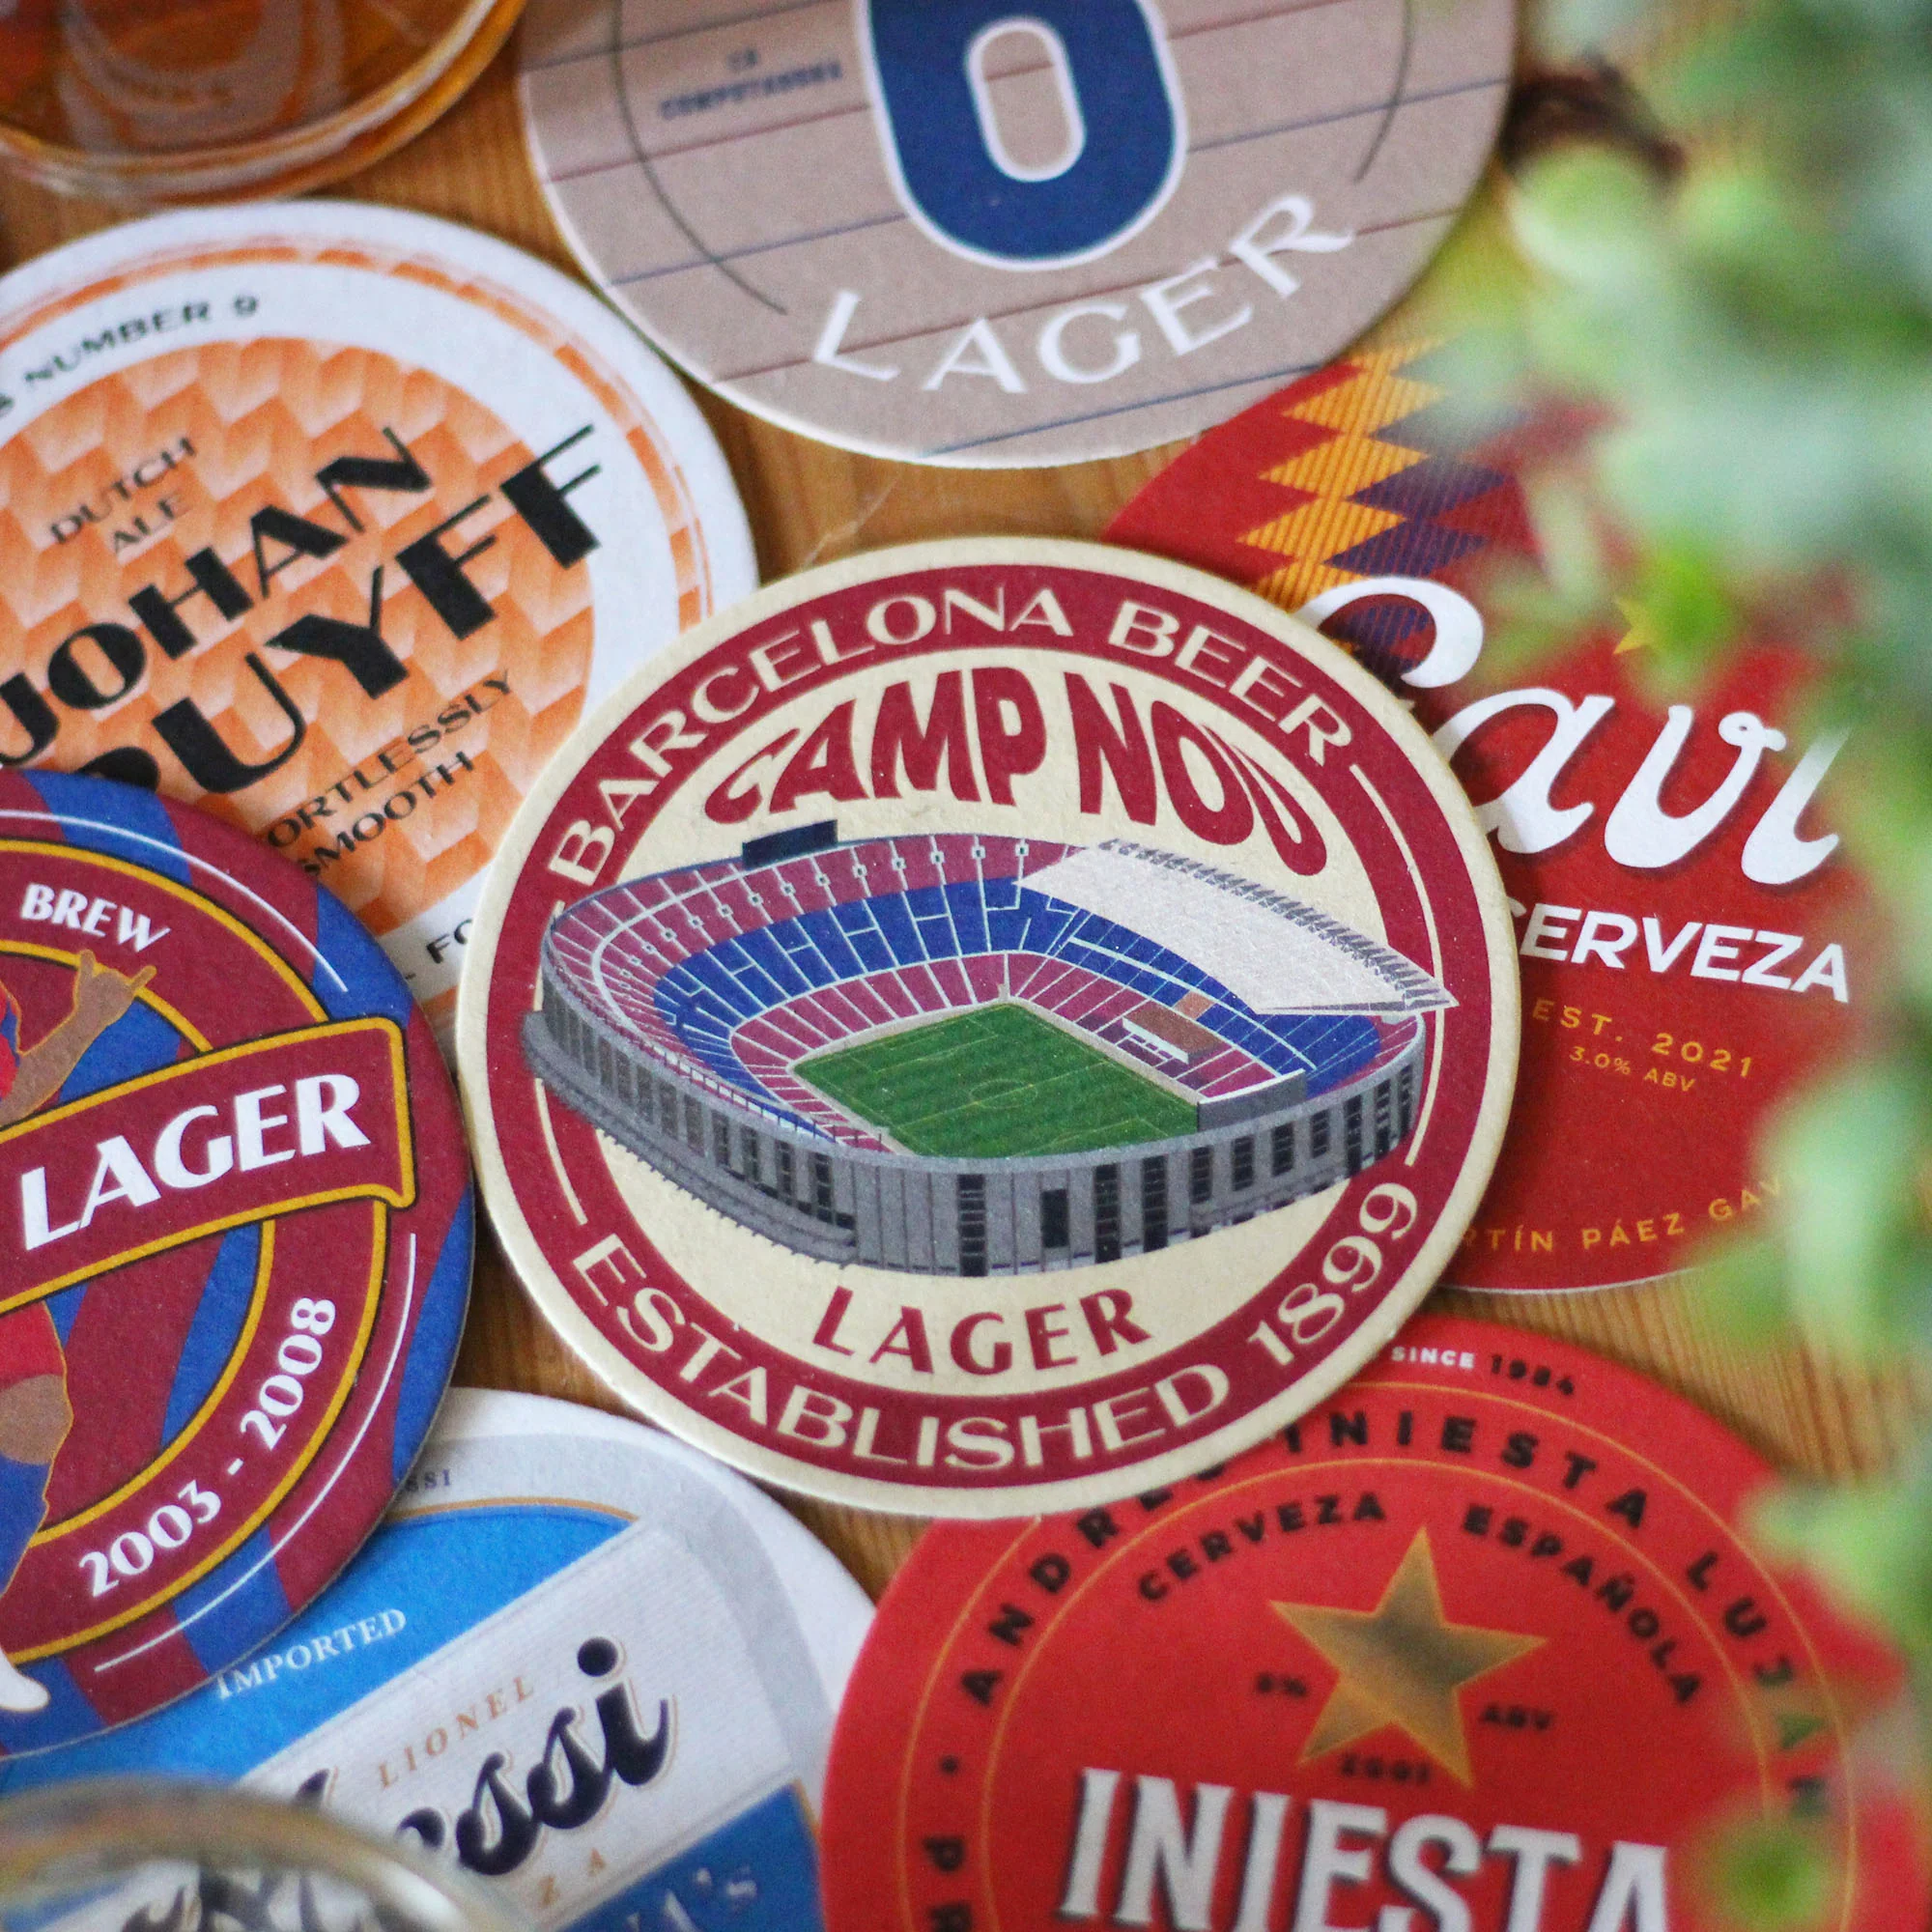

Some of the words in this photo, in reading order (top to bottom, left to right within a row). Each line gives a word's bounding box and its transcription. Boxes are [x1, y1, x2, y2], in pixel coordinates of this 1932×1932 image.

[24, 299, 211, 382] NUMBER
[233, 291, 259, 320] 9
[811, 193, 1355, 394] LAGER
[50, 436, 197, 544] DUTCH
[112, 490, 193, 554] ALE
[0, 426, 433, 766] JOHAN
[76, 424, 603, 794] UYFF
[267, 668, 511, 847] ORTLESSLY
[549, 582, 1074, 887] BARCELONA
[1108, 599, 1354, 769] BEER
[703, 666, 1048, 827] CAMP
[1063, 671, 1327, 876] NOU
[21, 883, 171, 953] BREW
[1508, 895, 1849, 1004] ERVEZA
[1532, 996, 1623, 1042] EST.
[1652, 1032, 1752, 1078] 2021
[1569, 1045, 1631, 1075] 3.0%
[1643, 1067, 1696, 1092] ABV
[19, 1073, 371, 1251] LAGER
[1581, 1211, 1685, 1249] PÁEZ
[574, 1235, 1230, 1472] ESTABLISHED
[1247, 1181, 1419, 1369] 1899
[812, 1285, 1152, 1377] LAGER
[1391, 1347, 1475, 1369] SINCE
[78, 1479, 222, 1598] 2003
[240, 1296, 336, 1451] 2008
[215, 1606, 408, 1701] IMPORTED
[1138, 1492, 1384, 1603] CERVEZA
[1464, 1503, 1701, 1707] ESPAÑOLA
[378, 1675, 535, 1789] LIONEL
[1060, 1767, 1668, 1932] INIESTA
